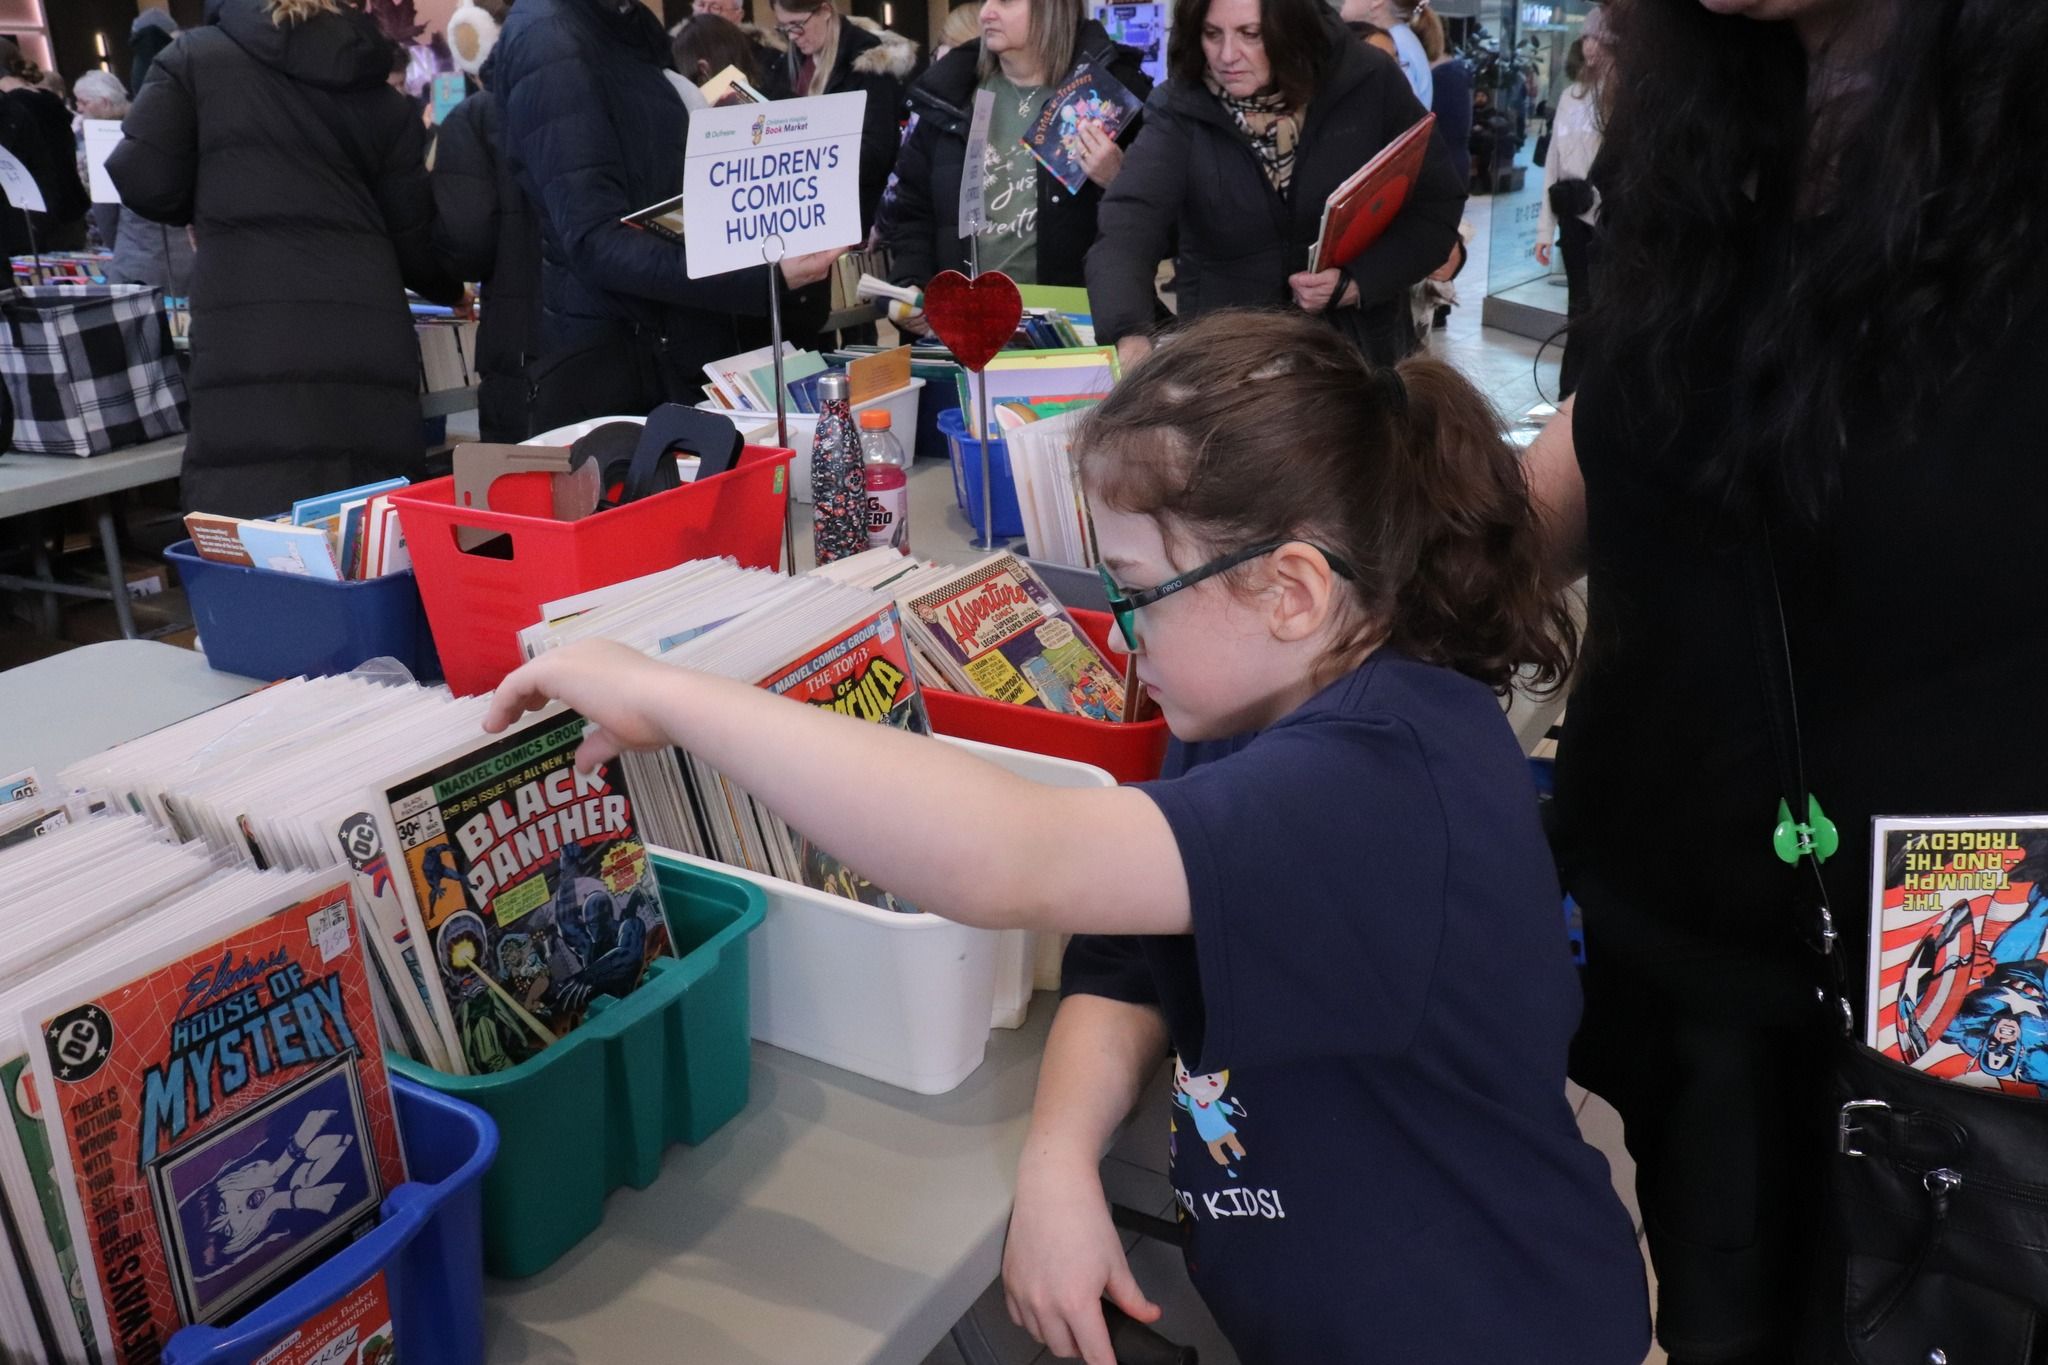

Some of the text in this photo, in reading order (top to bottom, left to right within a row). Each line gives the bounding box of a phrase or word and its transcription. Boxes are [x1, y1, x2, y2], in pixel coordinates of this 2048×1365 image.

[765, 122, 808, 135] Book Market
[709, 144, 839, 187] CHILDREN'S
[731, 176, 818, 213] COMICS
[991, 170, 1037, 211] jus
[726, 203, 826, 244] HUMOUR
[867, 496, 879, 511] G
[868, 511, 893, 525] ERO
[946, 582, 1028, 656] Adventure
[991, 605, 1015, 622] COMICS
[993, 613, 1020, 631] SUPERBOY
[980, 631, 1001, 648] LEGION
[775, 665, 812, 695] MARVEL
[812, 643, 847, 670] COMICS
[847, 623, 876, 648] GROUP
[805, 669, 833, 694] THE
[837, 678, 852, 696] OF
[438, 719, 586, 798] MARVEL COMICS GROUP
[401, 801, 429, 816] PANTHER
[402, 796, 423, 809] BLACK
[461, 796, 478, 812] BIG
[478, 781, 508, 804] ISSUE!
[507, 774, 524, 790] THE
[456, 763, 607, 863] BLACK
[352, 826, 374, 856] DC
[466, 795, 629, 911] PANTHER
[1906, 832, 2019, 850] TRAGEDY!
[1905, 853, 1945, 871] THE
[1904, 872, 2011, 890] TRIUMPH
[1903, 893, 1943, 911] THE
[174, 961, 305, 1052] HOUSE OF
[61, 1021, 94, 1062] DC
[140, 974, 357, 1170] MYSTERY
[71, 1086, 119, 1122] THERE IS
[74, 1103, 122, 1140] NOTHING
[78, 1125, 118, 1159] WRONG
[83, 1150, 112, 1175] WITH
[87, 1168, 116, 1195] YOUR
[95, 1196, 135, 1230] THIS IS
[1203, 1187, 1286, 1220] KIDS!
[98, 1228, 121, 1250] OUR
[102, 1230, 146, 1267] SPECIAL
[295, 1317, 339, 1350] Stacking
[340, 1289, 374, 1317] Basket
[297, 1333, 330, 1362] panier
[331, 1295, 379, 1336] empilable
